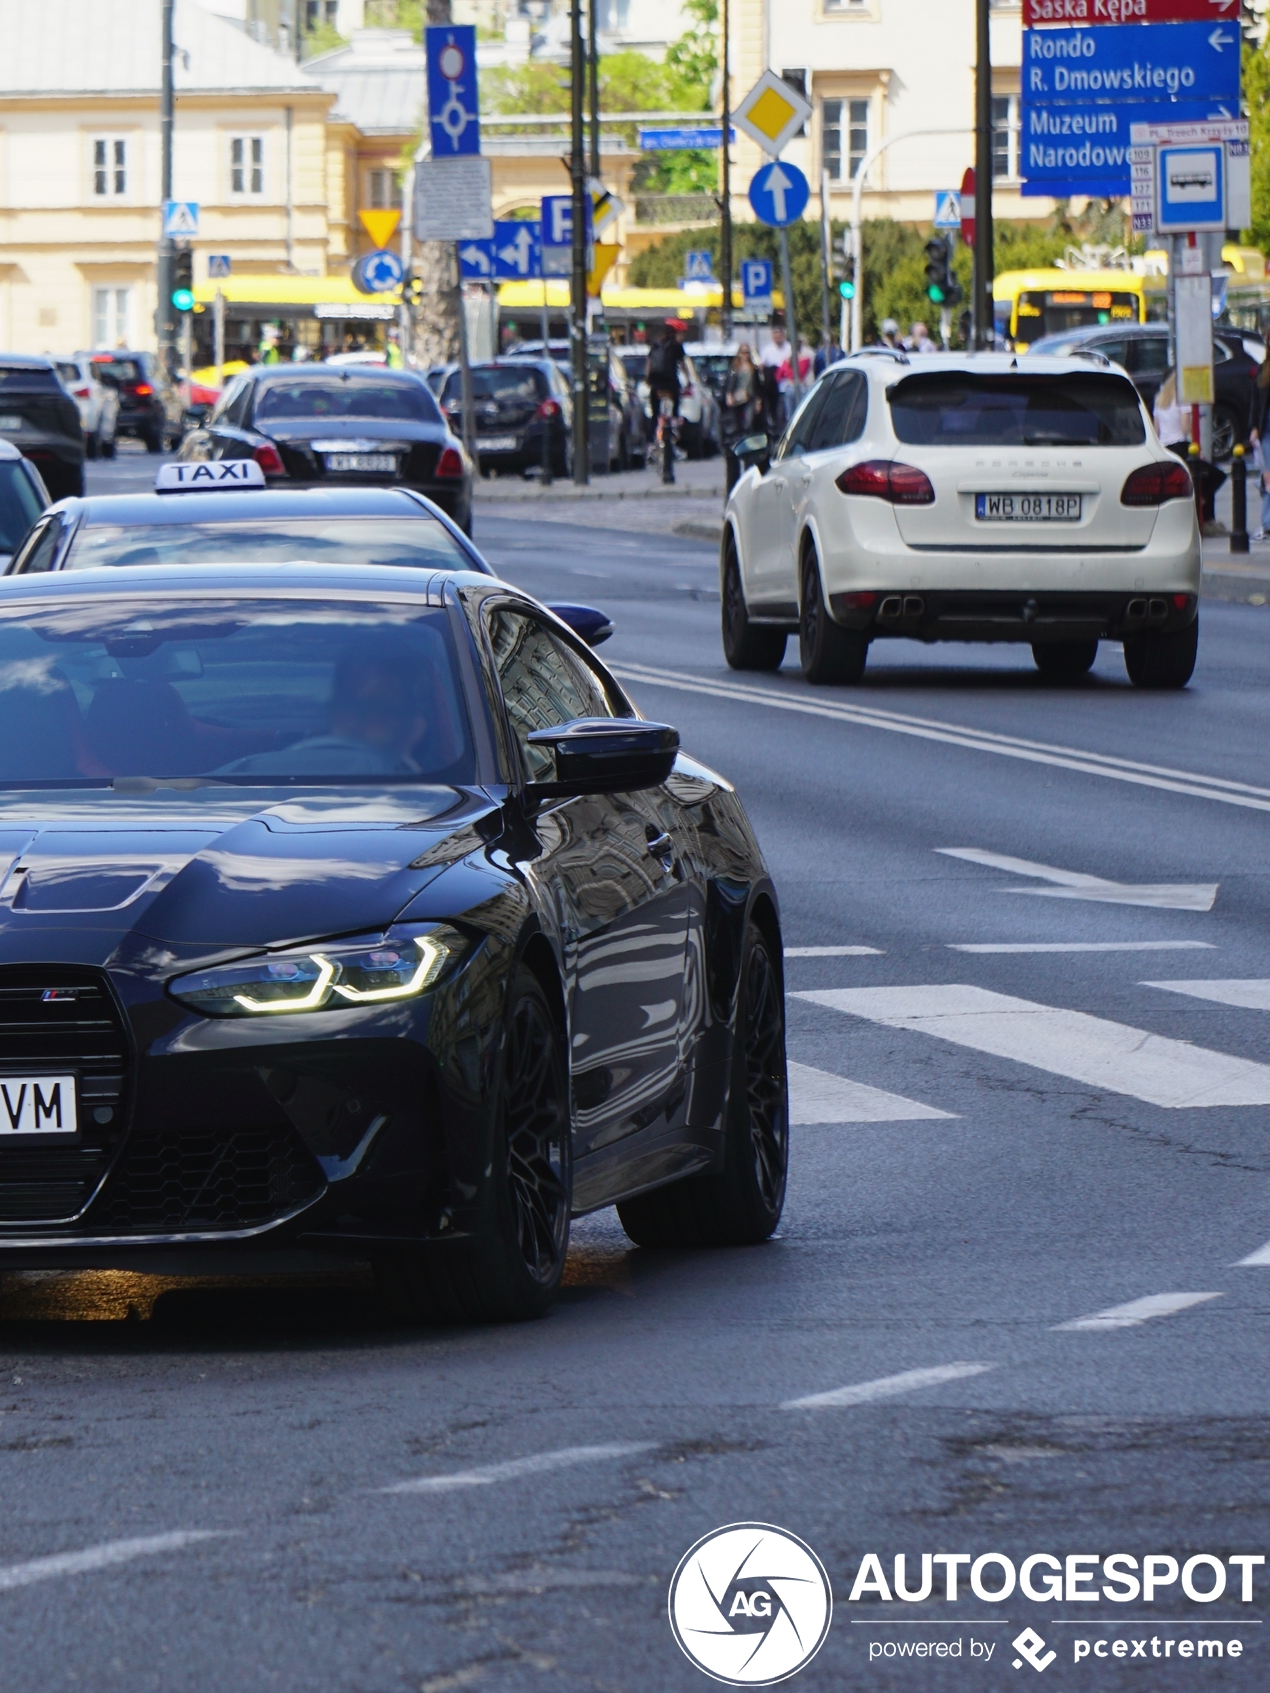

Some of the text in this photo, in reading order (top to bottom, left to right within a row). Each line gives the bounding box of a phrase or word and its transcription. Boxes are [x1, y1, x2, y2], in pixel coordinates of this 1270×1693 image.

[1031, 0, 1146, 22] Saska Kępa
[1030, 32, 1095, 58] Rondo
[1030, 62, 1195, 94] R. Dmowskiego
[1030, 110, 1117, 135] Muzeum
[1134, 150, 1150, 160] 109
[1135, 167, 1149, 177] 116
[1135, 184, 1150, 194] 127
[1133, 218, 1151, 229] N33
[748, 265, 767, 296] P
[170, 463, 248, 482] TAXI
[989, 498, 1014, 516] WB
[1021, 498, 1078, 516] 0818P
